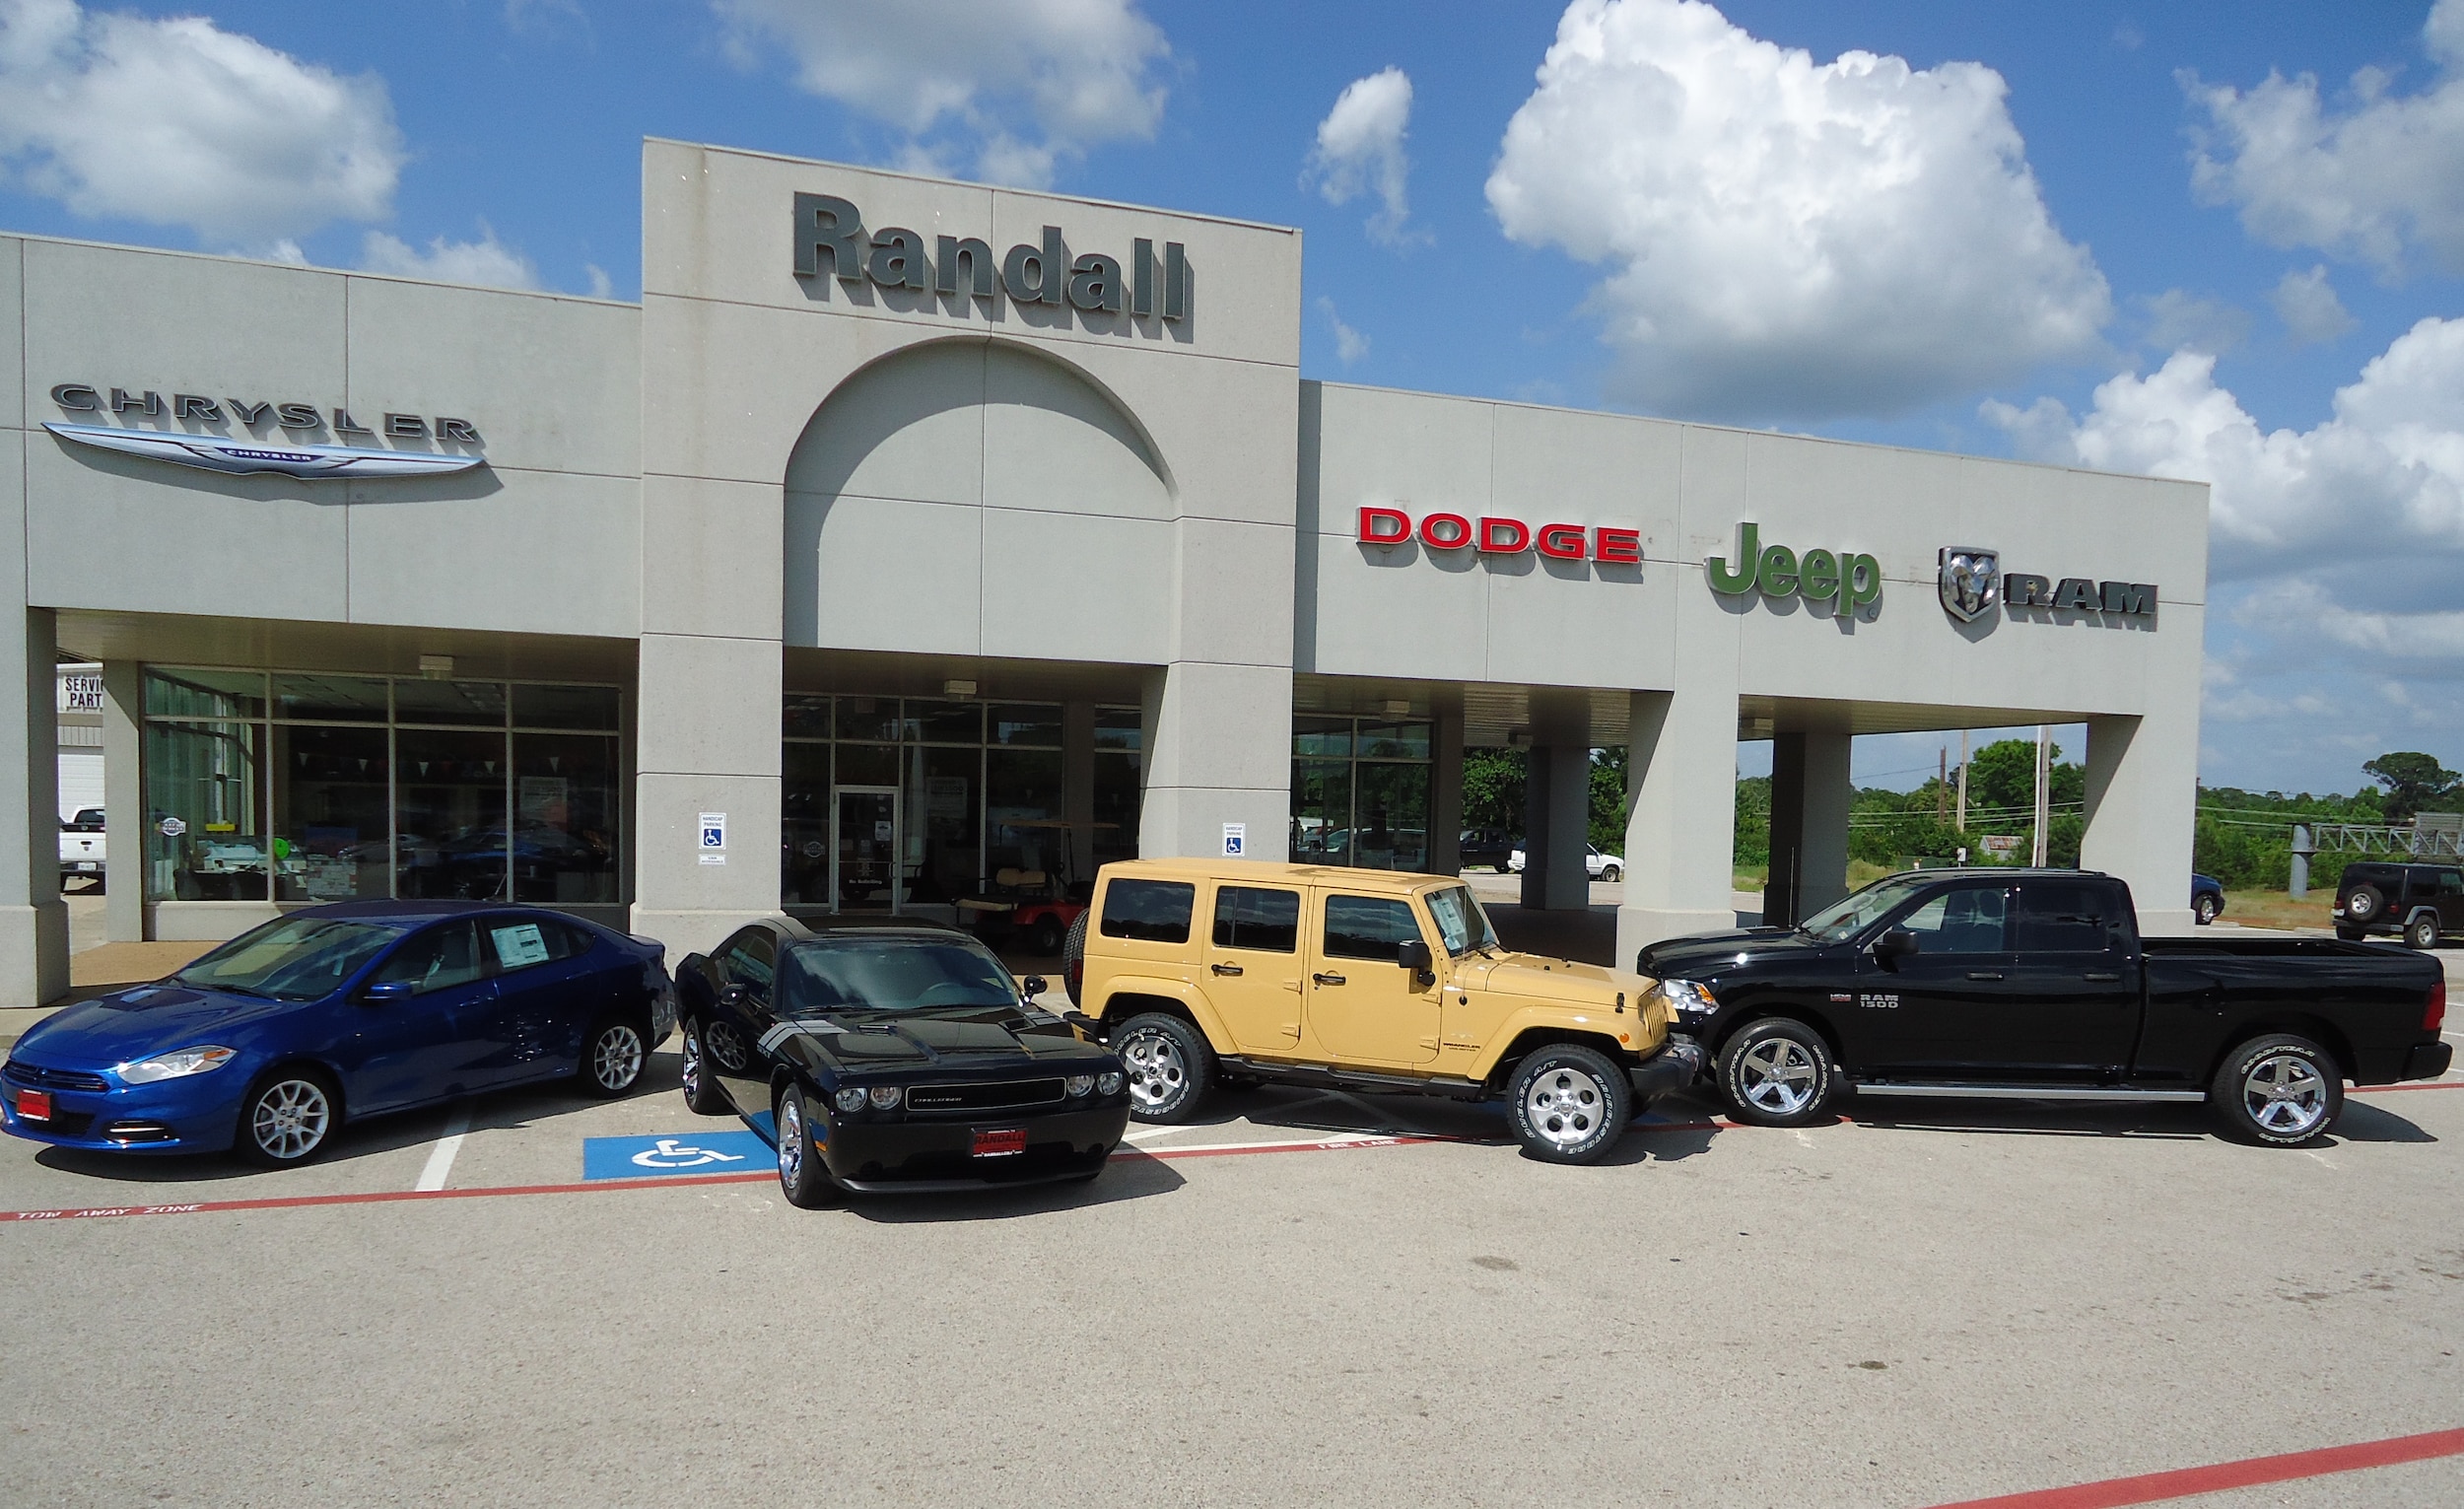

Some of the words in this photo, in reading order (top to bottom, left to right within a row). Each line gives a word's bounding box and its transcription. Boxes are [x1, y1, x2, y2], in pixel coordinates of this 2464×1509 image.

[793, 191, 1185, 320] Randall
[50, 383, 476, 443] CHRYSLER
[227, 449, 311, 461] CHRYSLER
[1356, 507, 1641, 564] DODGE
[1705, 522, 1881, 617] Jeep
[2004, 573, 2158, 614] RAM
[1729, 1038, 1751, 1108] GOODYEAR
[1808, 1044, 1828, 1112] WRANGLER
[2240, 1045, 2316, 1074] GOODYEAR
[1516, 1076, 1537, 1138] DUELER
[1533, 1060, 1558, 1077] A/T
[1567, 1073, 1613, 1155] BRIDGESTONE
[975, 1132, 1024, 1144] RANDALL
[1358, 1138, 1402, 1147] LANE
[2258, 1117, 2331, 1143] WRANGLER
[74, 1208, 132, 1218] AWAY
[143, 1203, 204, 1214] ZONE
